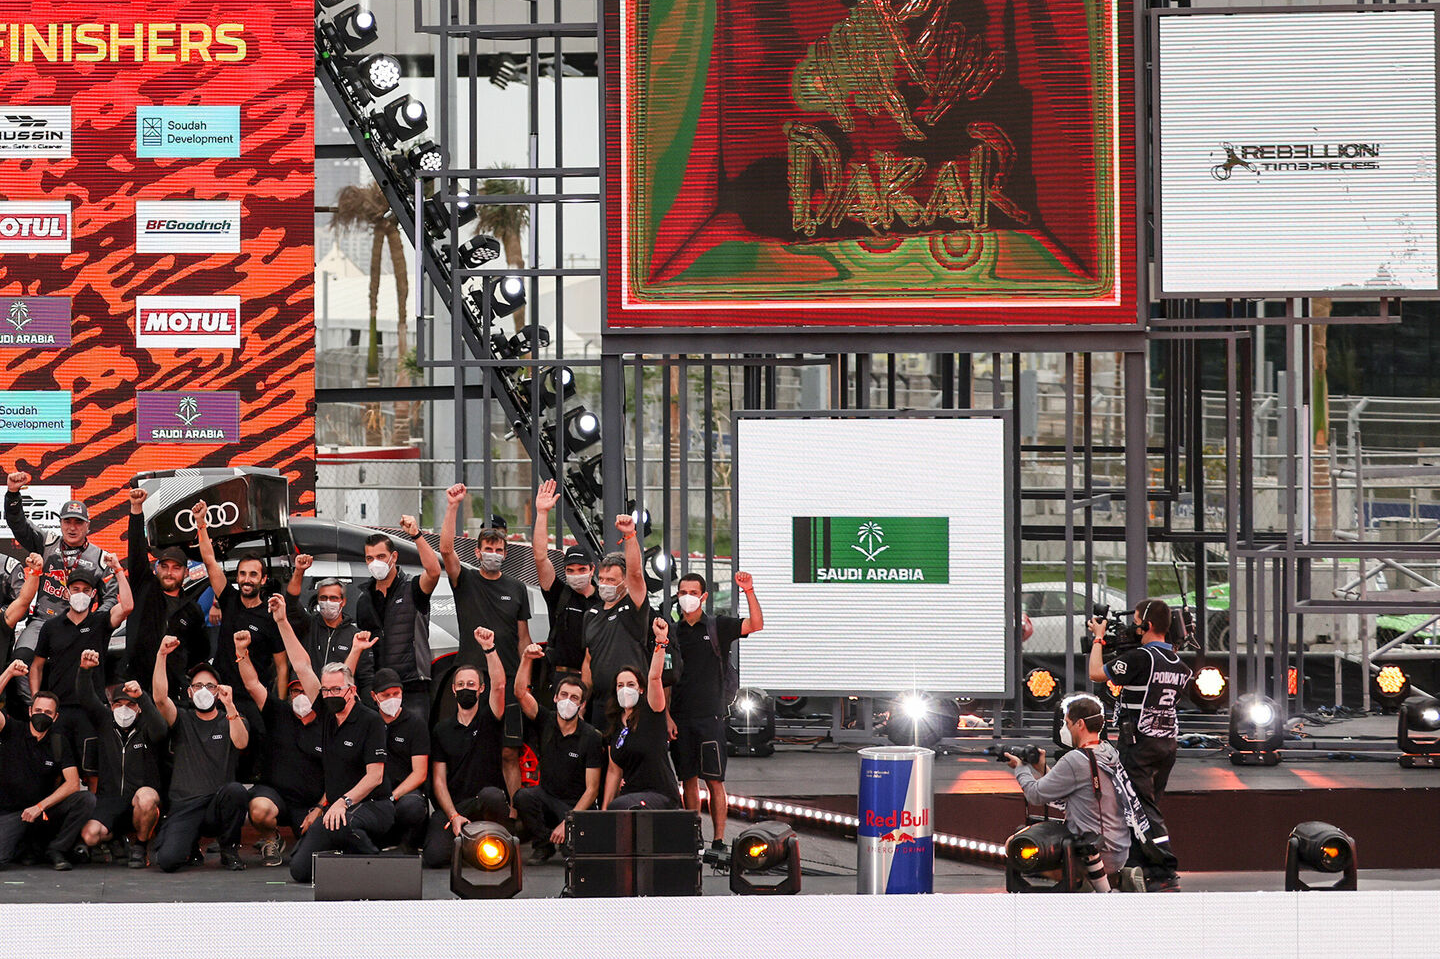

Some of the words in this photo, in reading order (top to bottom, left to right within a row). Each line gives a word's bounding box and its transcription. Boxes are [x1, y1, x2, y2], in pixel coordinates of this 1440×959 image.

[167, 120, 207, 131] Soudah
[167, 134, 234, 146] Development
[783, 122, 1031, 236] DAKAR
[145, 219, 232, 230] BFGoodrich
[144, 312, 233, 332] MOTUL
[16, 334, 55, 344] ARABIA
[151, 428, 183, 439] SAUDI
[184, 428, 225, 439] ARABIA
[816, 568, 863, 581] SAUDI
[865, 568, 925, 581] ARABIA
[866, 809, 897, 827] Red
[900, 808, 929, 827] Bull
